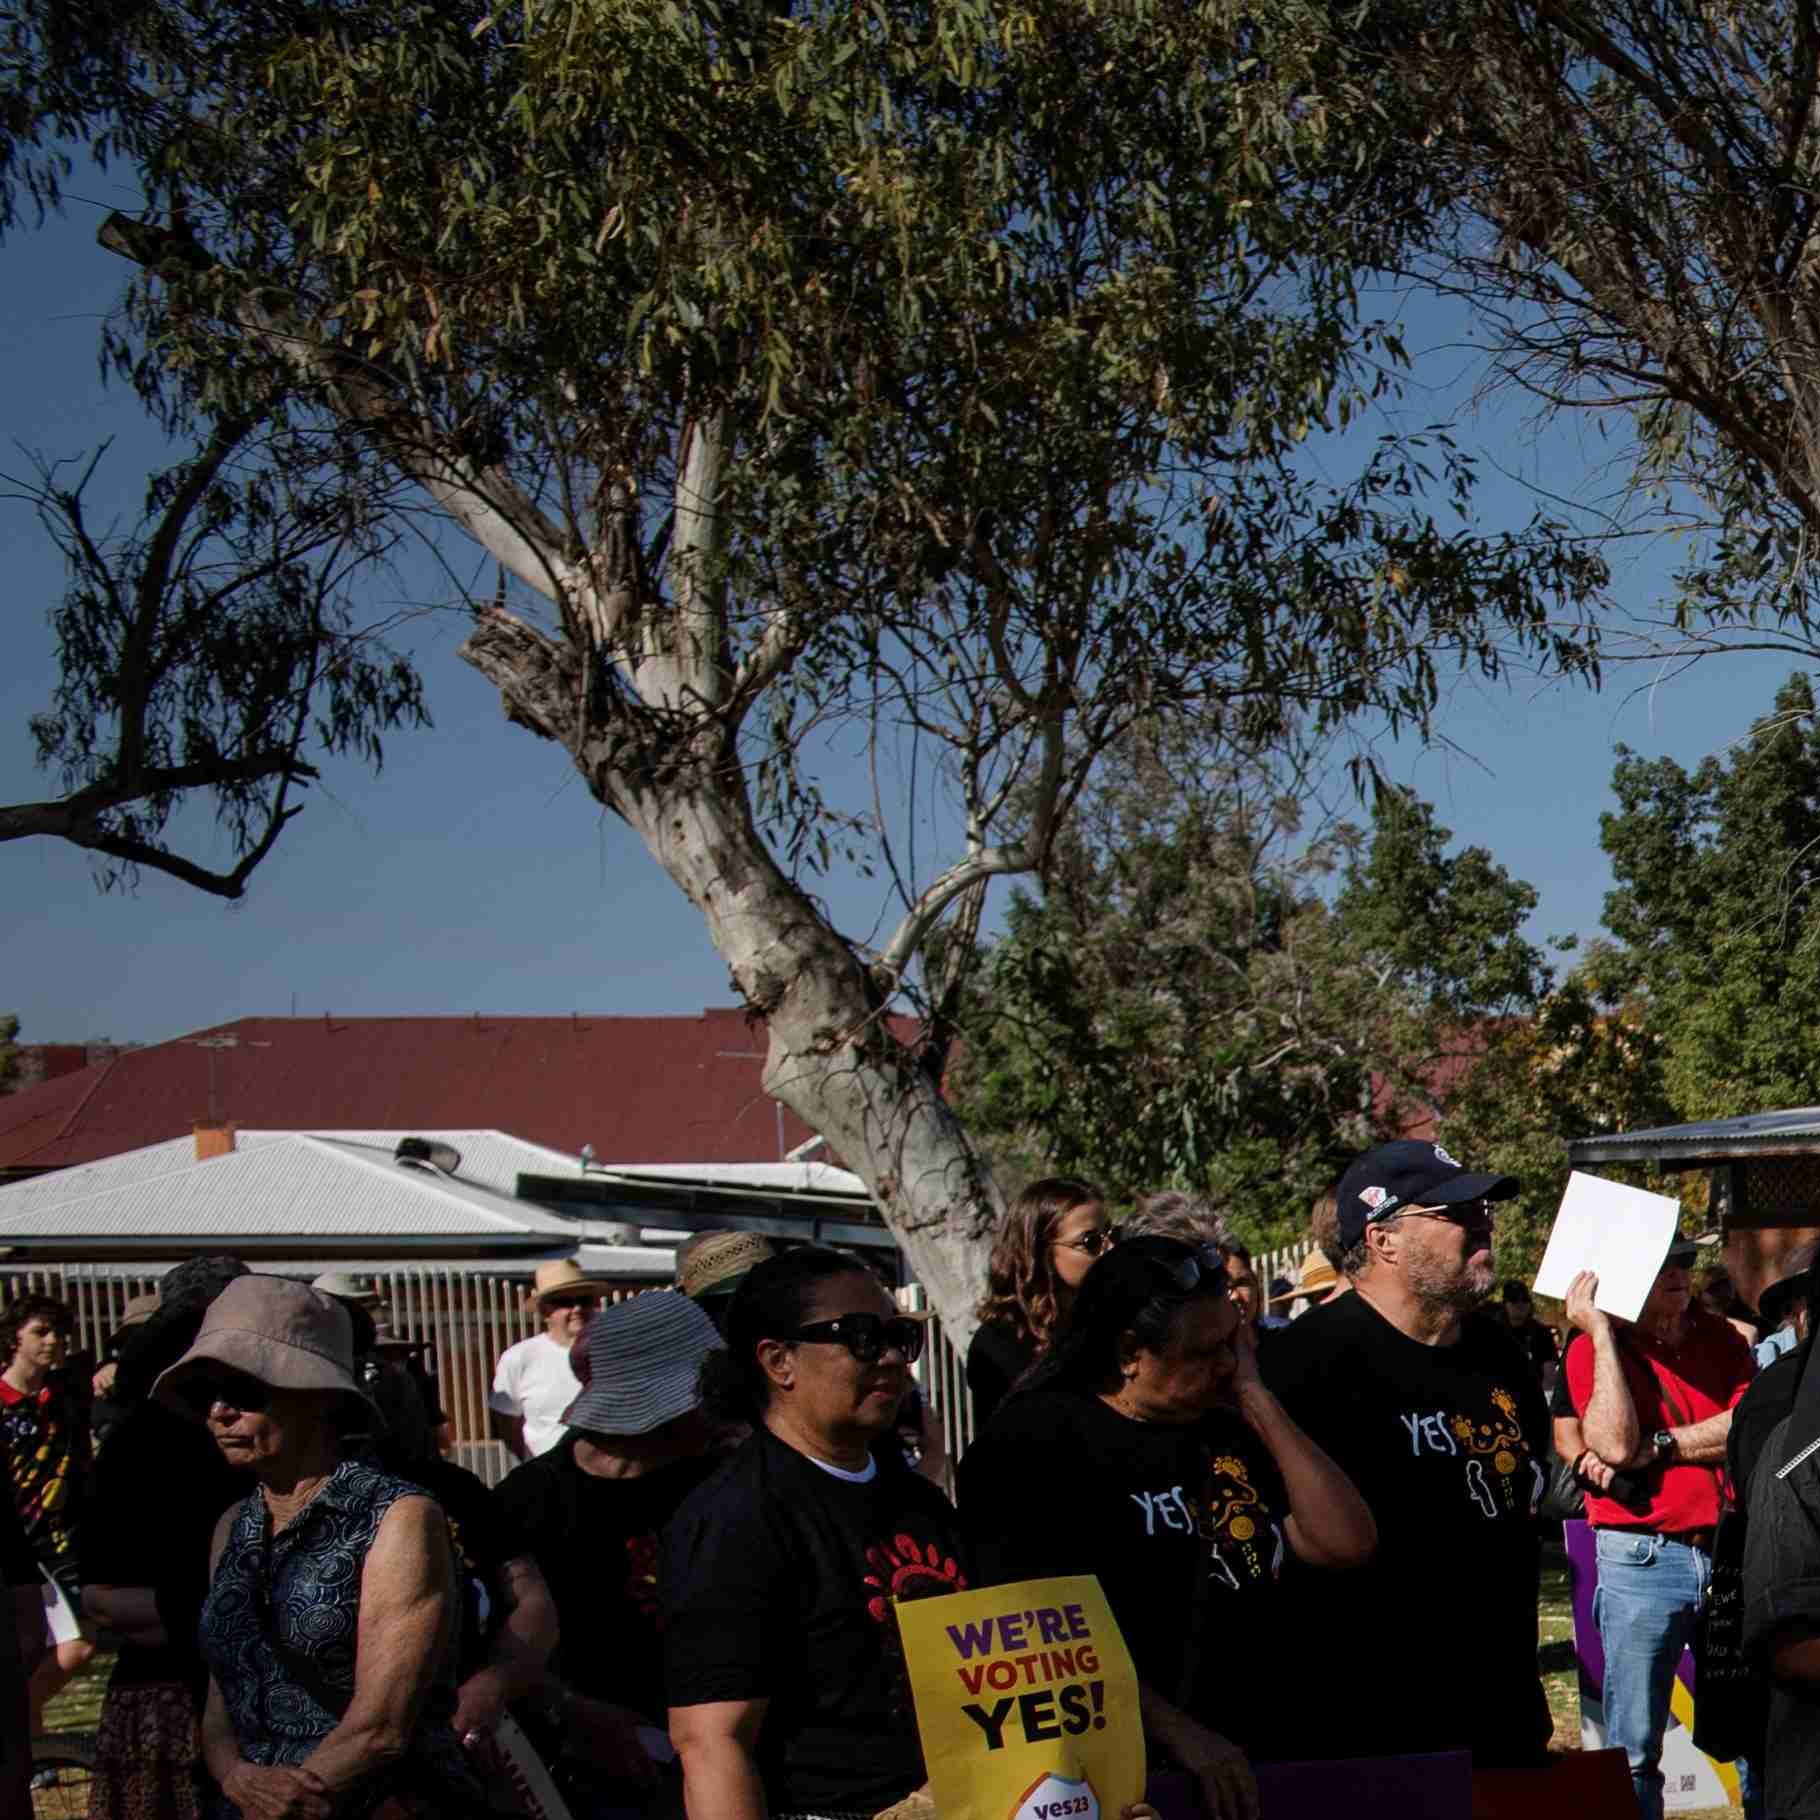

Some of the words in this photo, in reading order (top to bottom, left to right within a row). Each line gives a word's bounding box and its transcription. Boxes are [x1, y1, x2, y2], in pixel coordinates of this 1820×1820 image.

[1399, 1409, 1459, 1458] YES
[1128, 1484, 1196, 1537] YES
[946, 1604, 1091, 1659] WE'RE
[956, 1645, 1101, 1696] VOTING
[961, 1681, 1106, 1750] YES!
